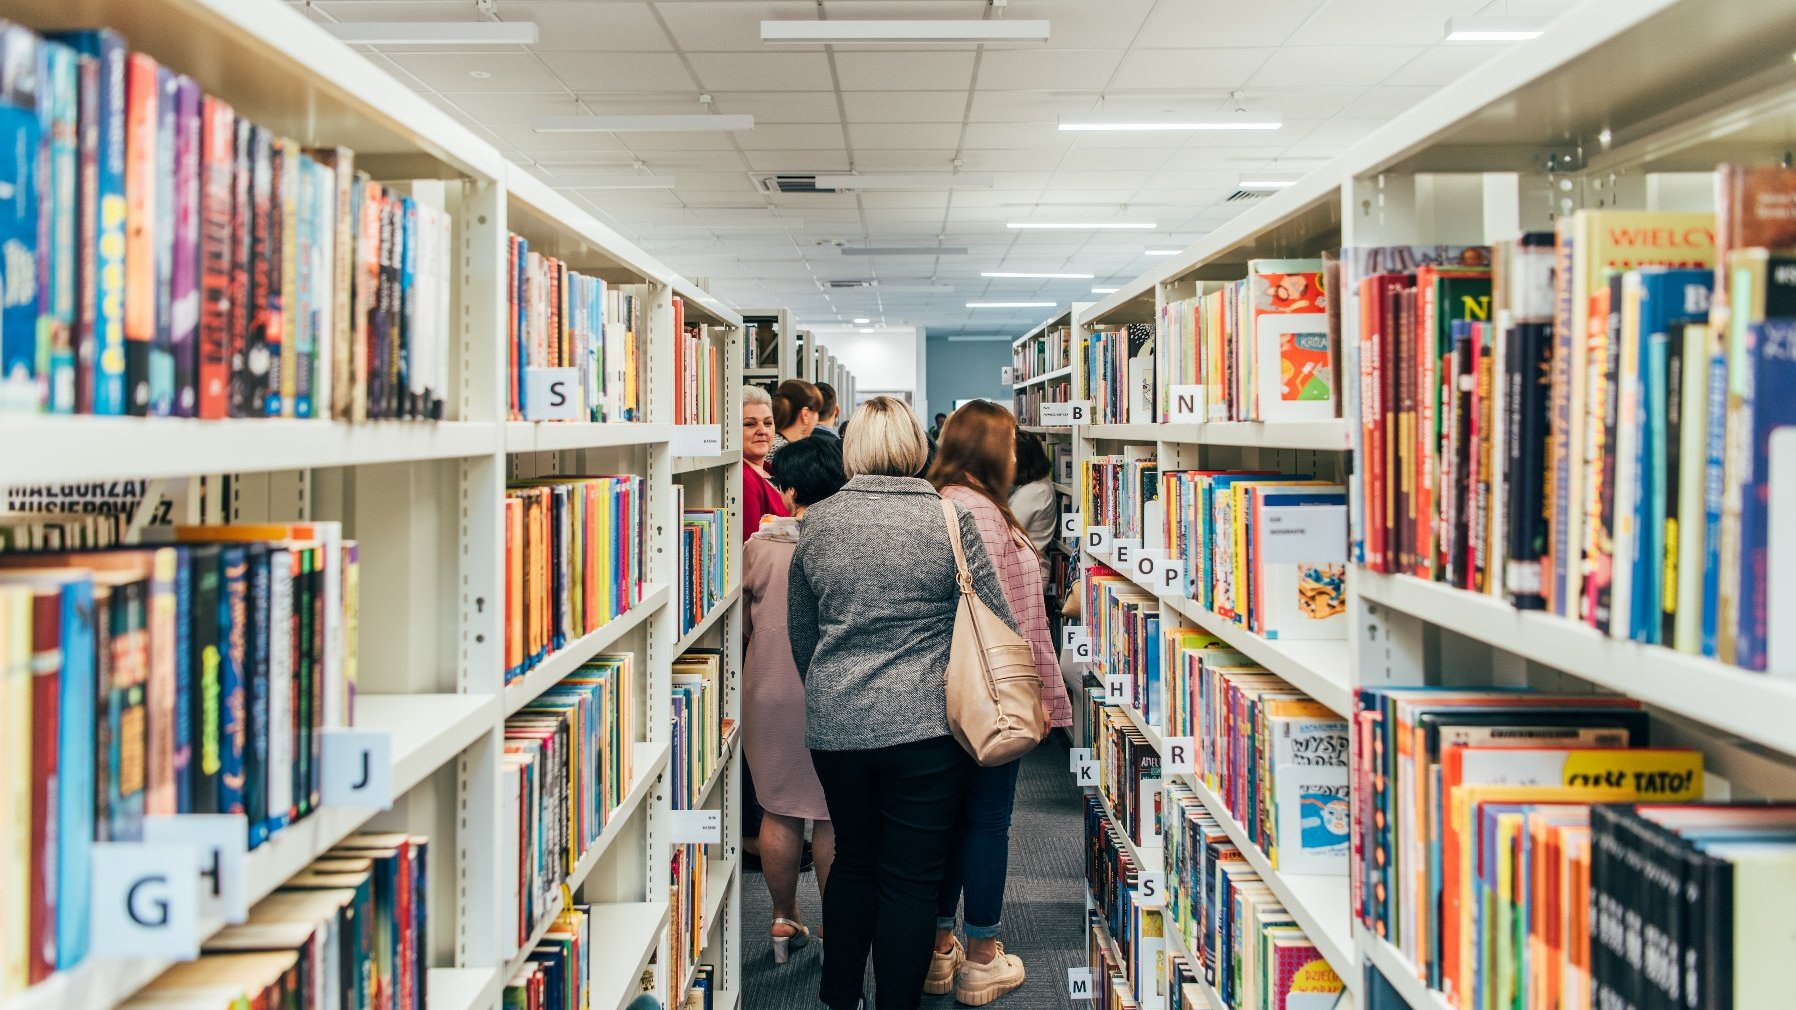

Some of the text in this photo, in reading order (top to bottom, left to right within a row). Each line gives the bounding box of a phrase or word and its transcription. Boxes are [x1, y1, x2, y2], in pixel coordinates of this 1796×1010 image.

[550, 381, 566, 406] S
[1178, 394, 1194, 414] N
[1073, 406, 1083, 420] B
[1065, 519, 1075, 532] C
[1089, 532, 1103, 547] D
[1118, 546, 1128, 562] E
[1138, 557, 1154, 575] O
[1165, 568, 1178, 587] P
[1067, 631, 1076, 645] F
[1077, 643, 1088, 657] G
[1110, 681, 1123, 697] H
[1171, 745, 1185, 764] R
[350, 751, 370, 790] J
[1081, 766, 1092, 780] K
[1634, 769, 1695, 793] TATO!
[1143, 879, 1155, 897] S
[126, 875, 169, 928] G
[1072, 980, 1087, 994] M
